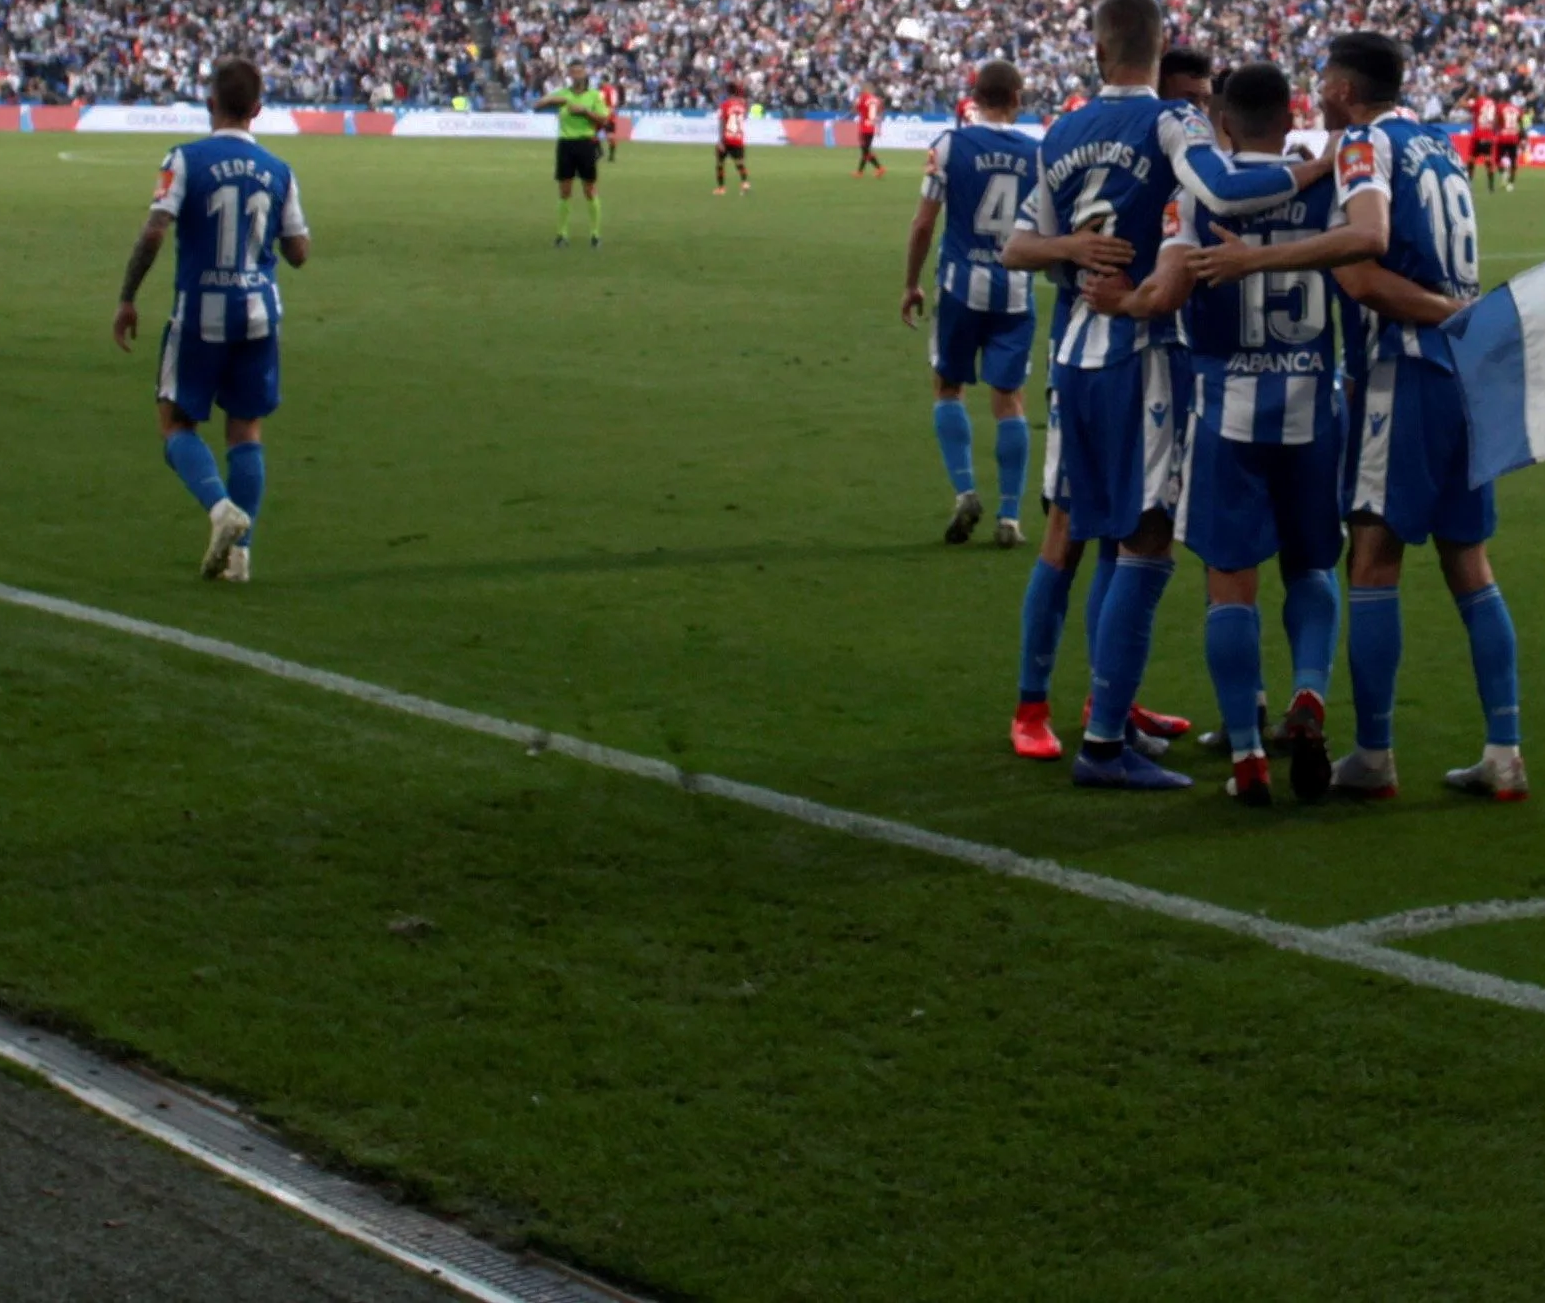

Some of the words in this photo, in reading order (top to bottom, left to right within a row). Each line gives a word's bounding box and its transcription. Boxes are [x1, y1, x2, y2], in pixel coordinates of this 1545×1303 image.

[207, 185, 271, 272] 11
[973, 173, 1019, 248] 4
[1417, 168, 1479, 285] 18
[1239, 229, 1327, 347] 15
[1227, 352, 1325, 373] ABANCA
